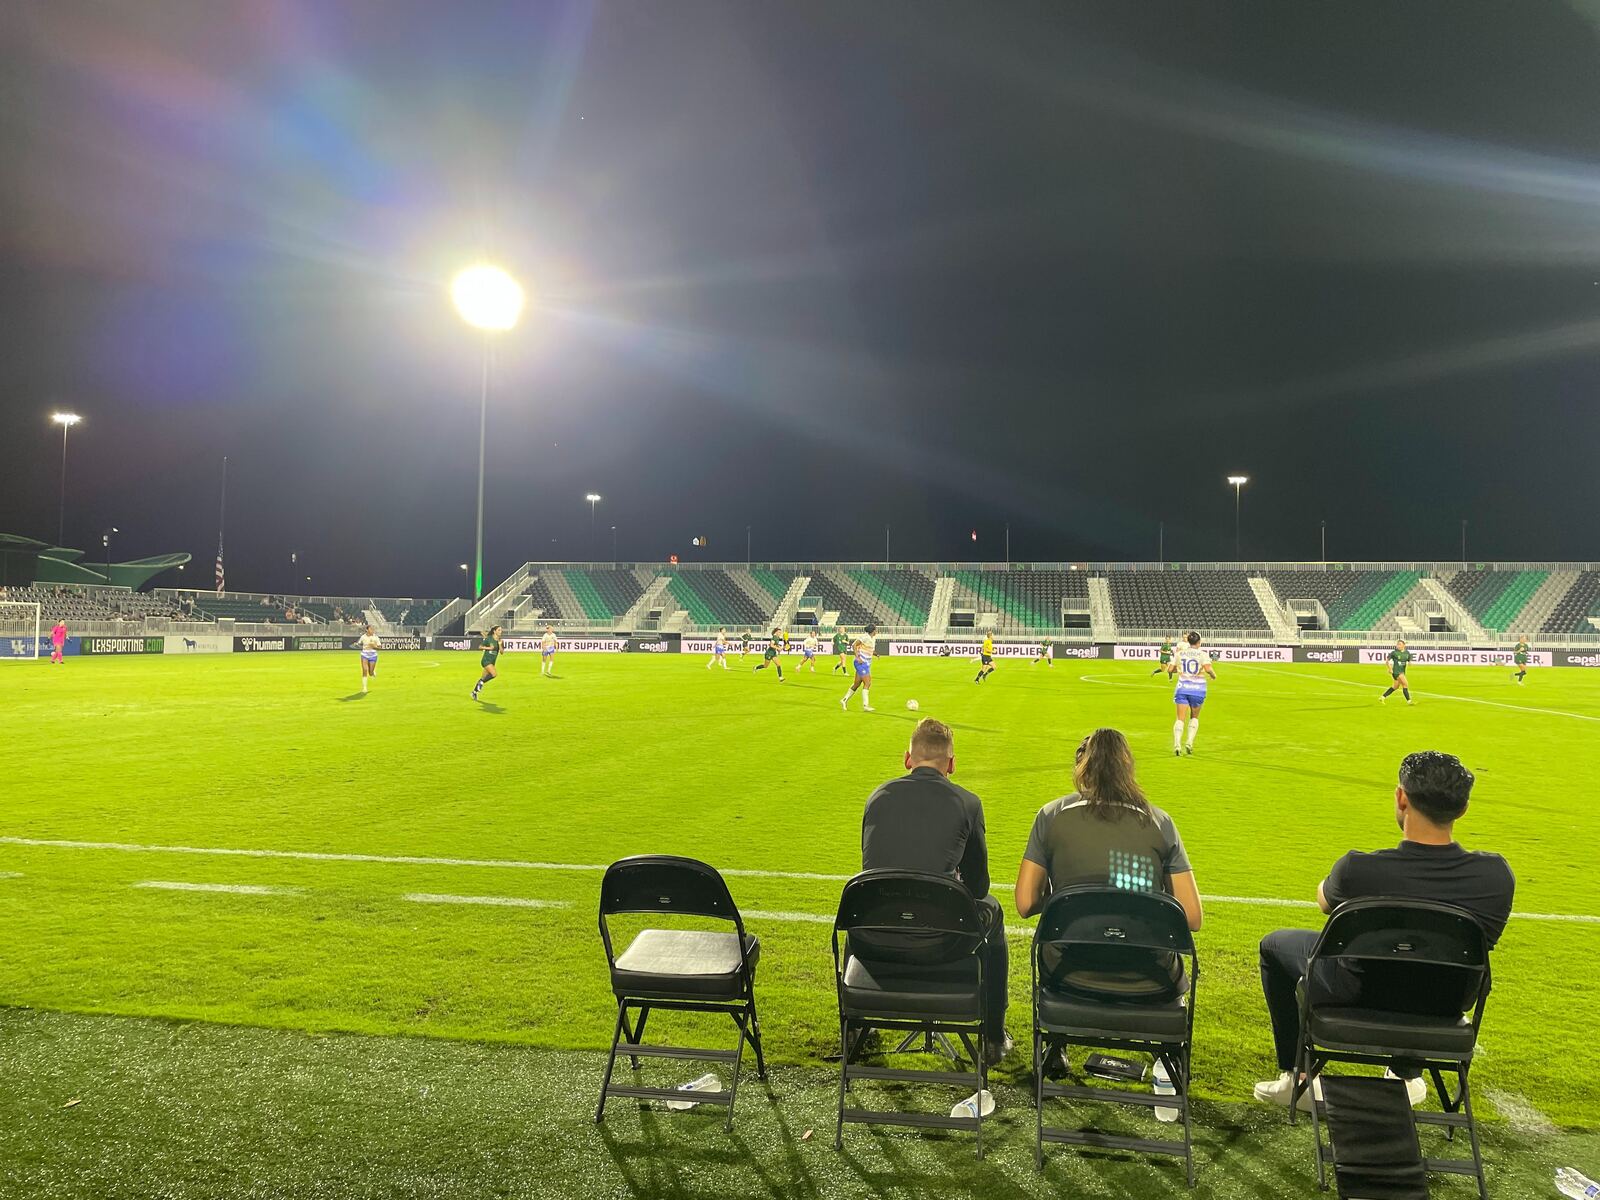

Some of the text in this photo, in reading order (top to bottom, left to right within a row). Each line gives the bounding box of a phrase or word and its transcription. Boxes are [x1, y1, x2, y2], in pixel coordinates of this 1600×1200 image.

[253, 638, 285, 651] hummel
[443, 640, 471, 650] capelli
[639, 641, 668, 651] capelli
[687, 643, 712, 651] YOUR
[896, 645, 923, 654] YOUR
[925, 646, 982, 655] TEAMSPOR
[1066, 646, 1099, 658] capelli
[1121, 649, 1151, 657] YOUR
[1306, 650, 1343, 661] capelli
[1410, 653, 1477, 663] EAMSPORT
[1567, 655, 1600, 666] capell
[1181, 658, 1199, 675] 10
